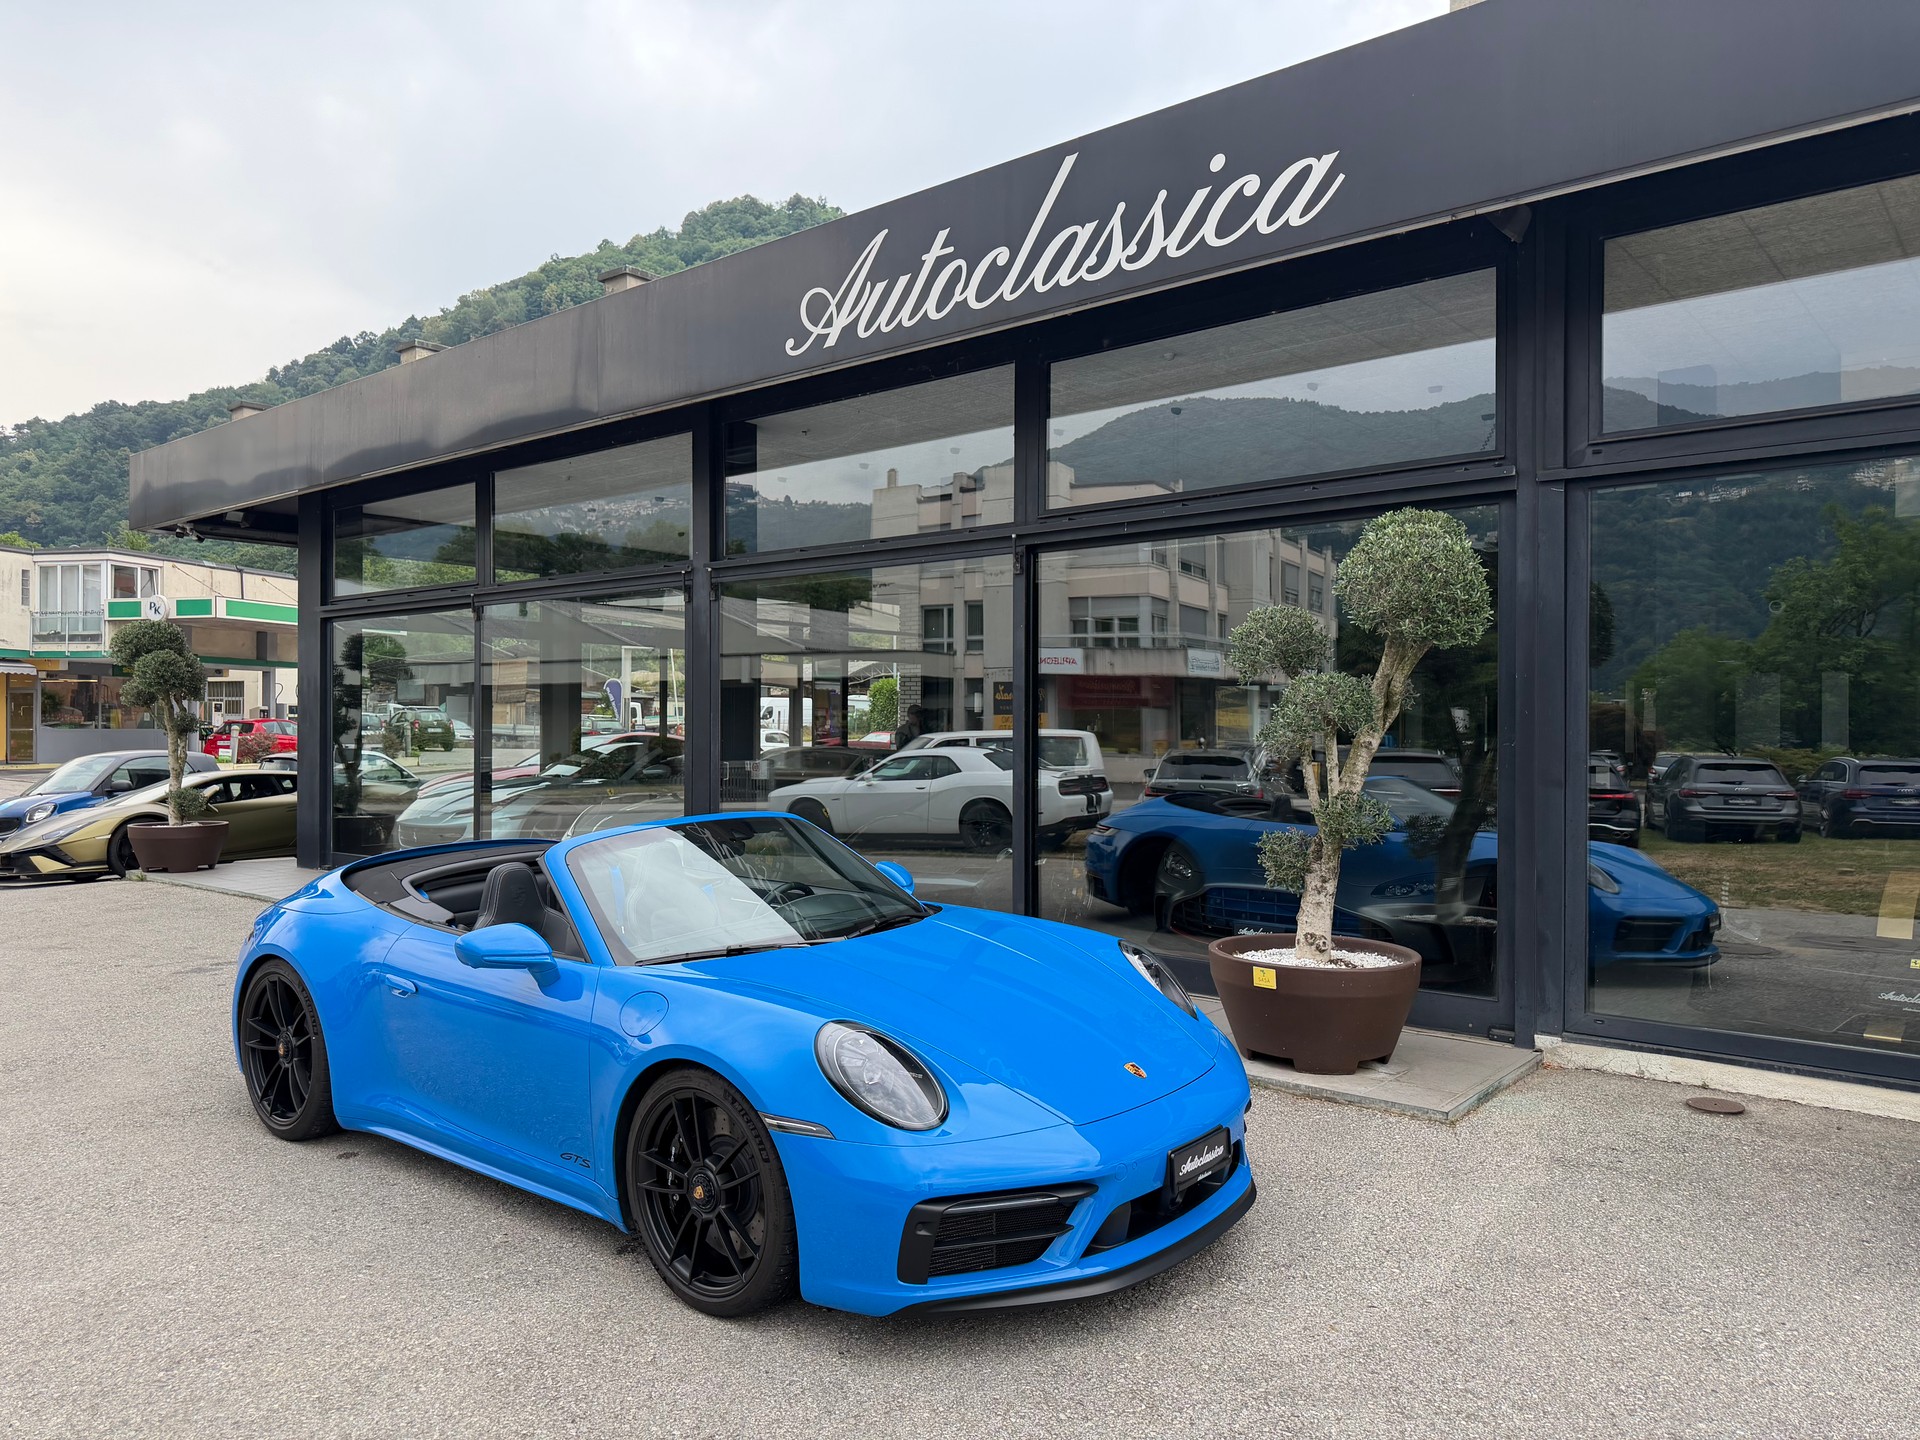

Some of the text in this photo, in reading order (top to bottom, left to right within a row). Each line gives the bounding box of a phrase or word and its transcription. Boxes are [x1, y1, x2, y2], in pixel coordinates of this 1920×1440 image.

[785, 150, 1346, 357] Autoclassica
[733, 1100, 771, 1162] MICHELIN
[560, 1152, 591, 1169] GTS
[1179, 1145, 1225, 1177] Autoclassica
